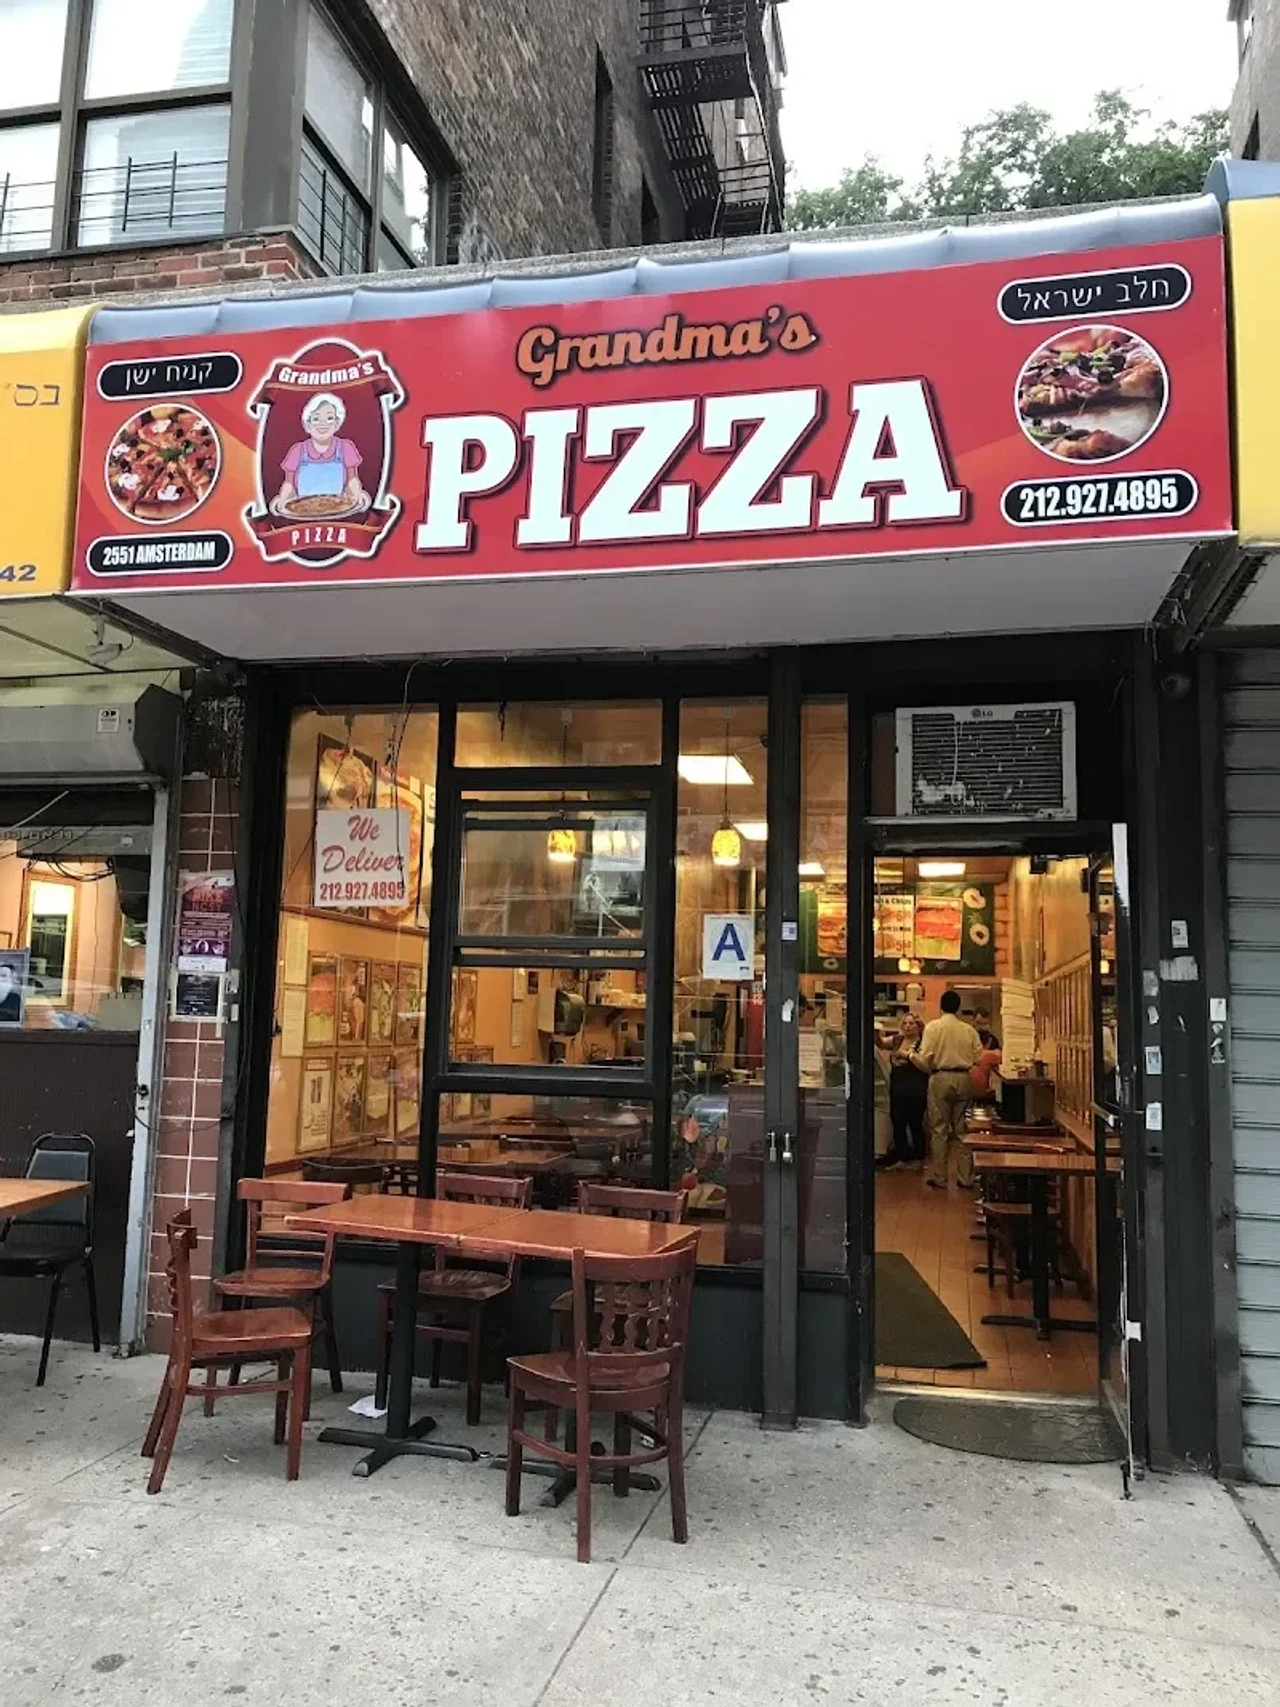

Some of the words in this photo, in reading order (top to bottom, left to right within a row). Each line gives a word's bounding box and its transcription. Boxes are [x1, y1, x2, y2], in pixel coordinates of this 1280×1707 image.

[1017, 286, 1102, 312] ישראל
[1116, 275, 1169, 302] חלב
[516, 307, 817, 386] Grandma's
[126, 367, 157, 392] ישן
[279, 362, 375, 385] Grandma's
[414, 378, 963, 553] PIZZA
[1019, 477, 1178, 519] 212.927.4895
[291, 526, 347, 546] PIZZA
[102, 546, 135, 566] 2551
[135, 541, 216, 564] AMSTERDAM
[347, 814, 380, 841] We
[321, 845, 404, 873] Deliver
[320, 881, 405, 900] 212.927.4895
[711, 923, 746, 961] A
